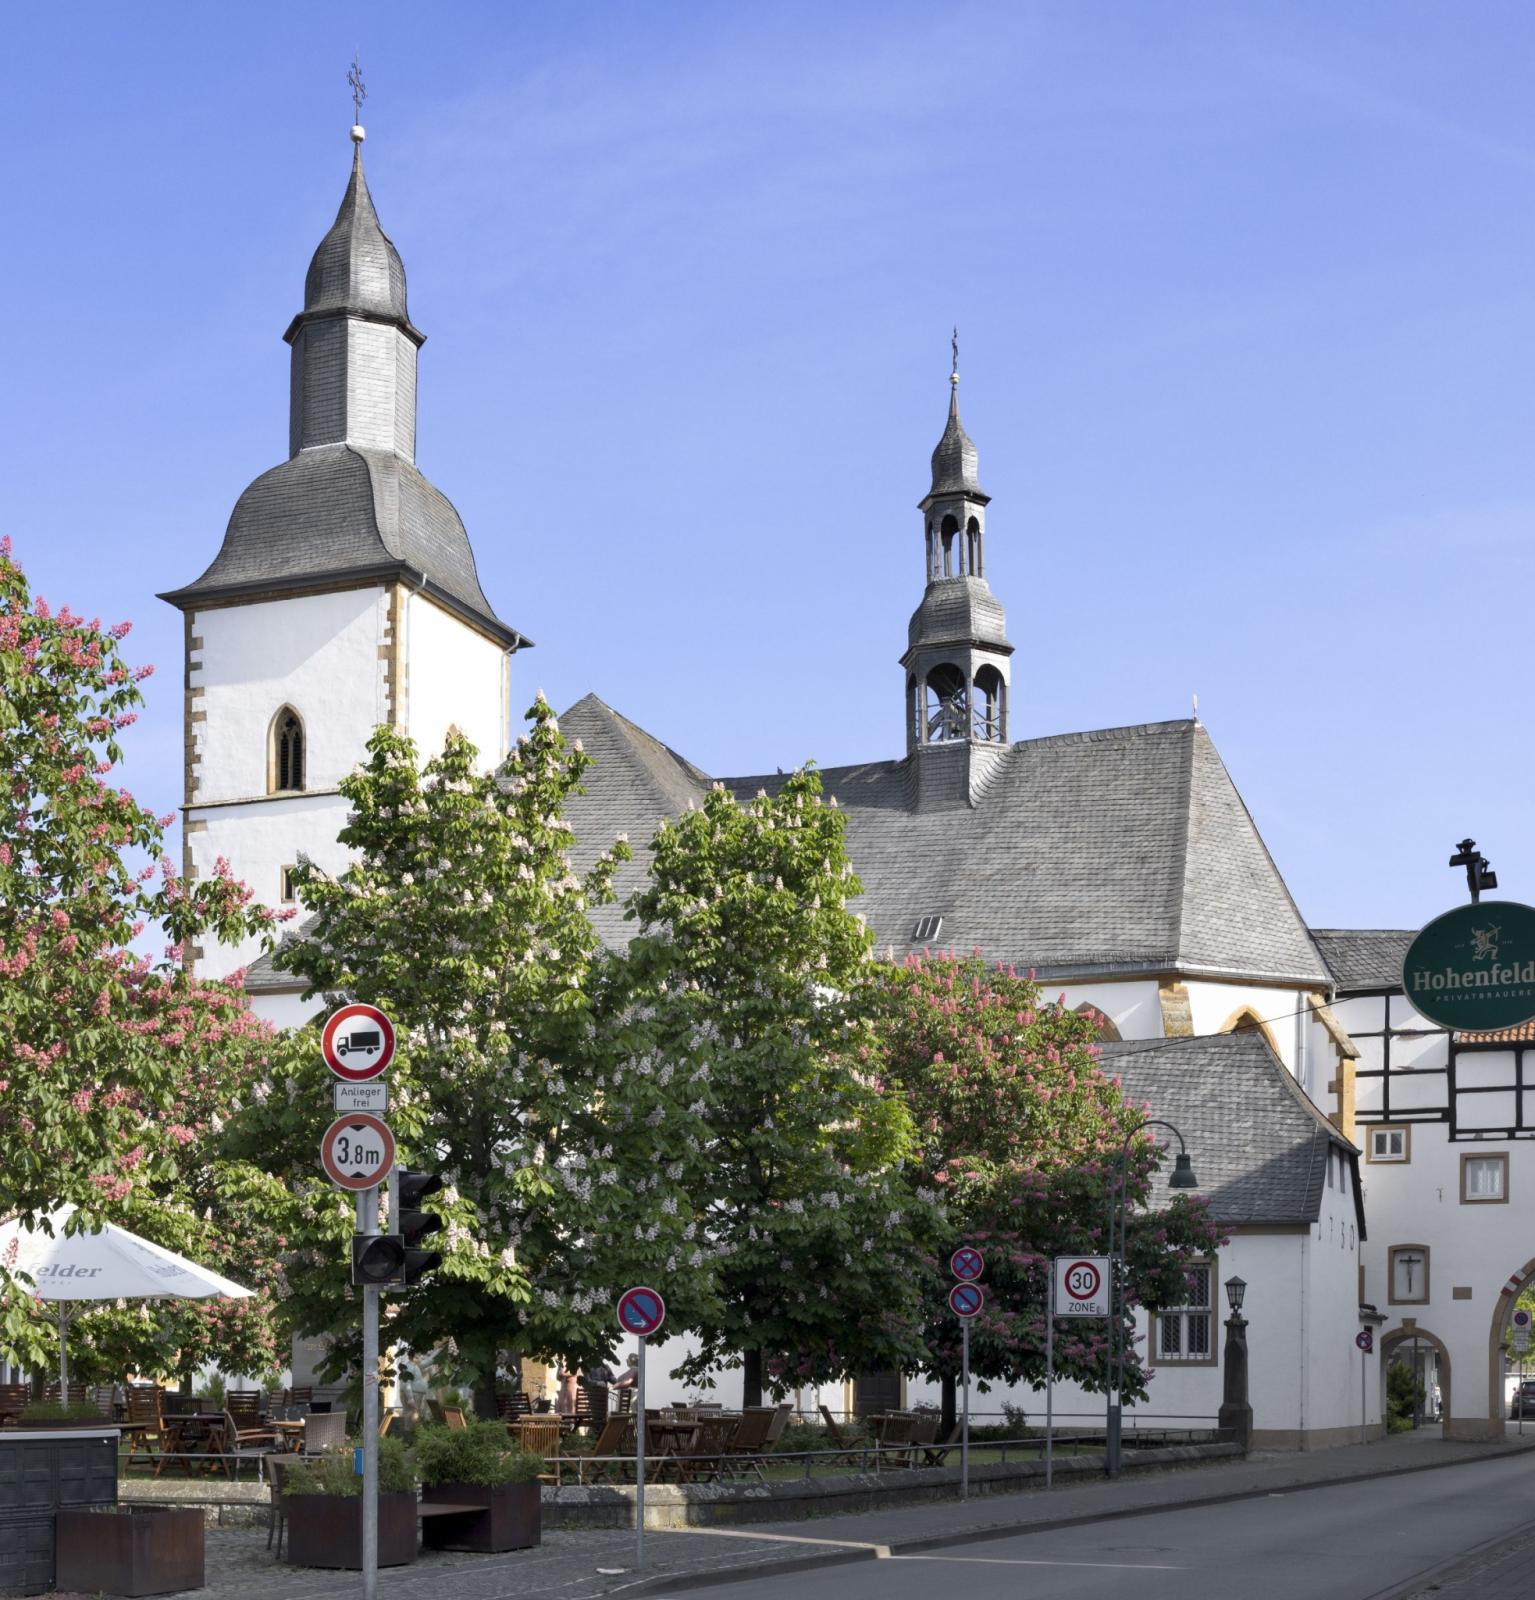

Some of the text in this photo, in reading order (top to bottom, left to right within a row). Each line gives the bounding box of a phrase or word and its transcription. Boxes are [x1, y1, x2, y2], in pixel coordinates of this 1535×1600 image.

[1413, 960, 1535, 991] Hohenfeld
[340, 1087, 382, 1099] Anlieger
[352, 1096, 370, 1108] frei
[1072, 1272, 1093, 1290] 30
[1068, 1302, 1096, 1313] ZONE
